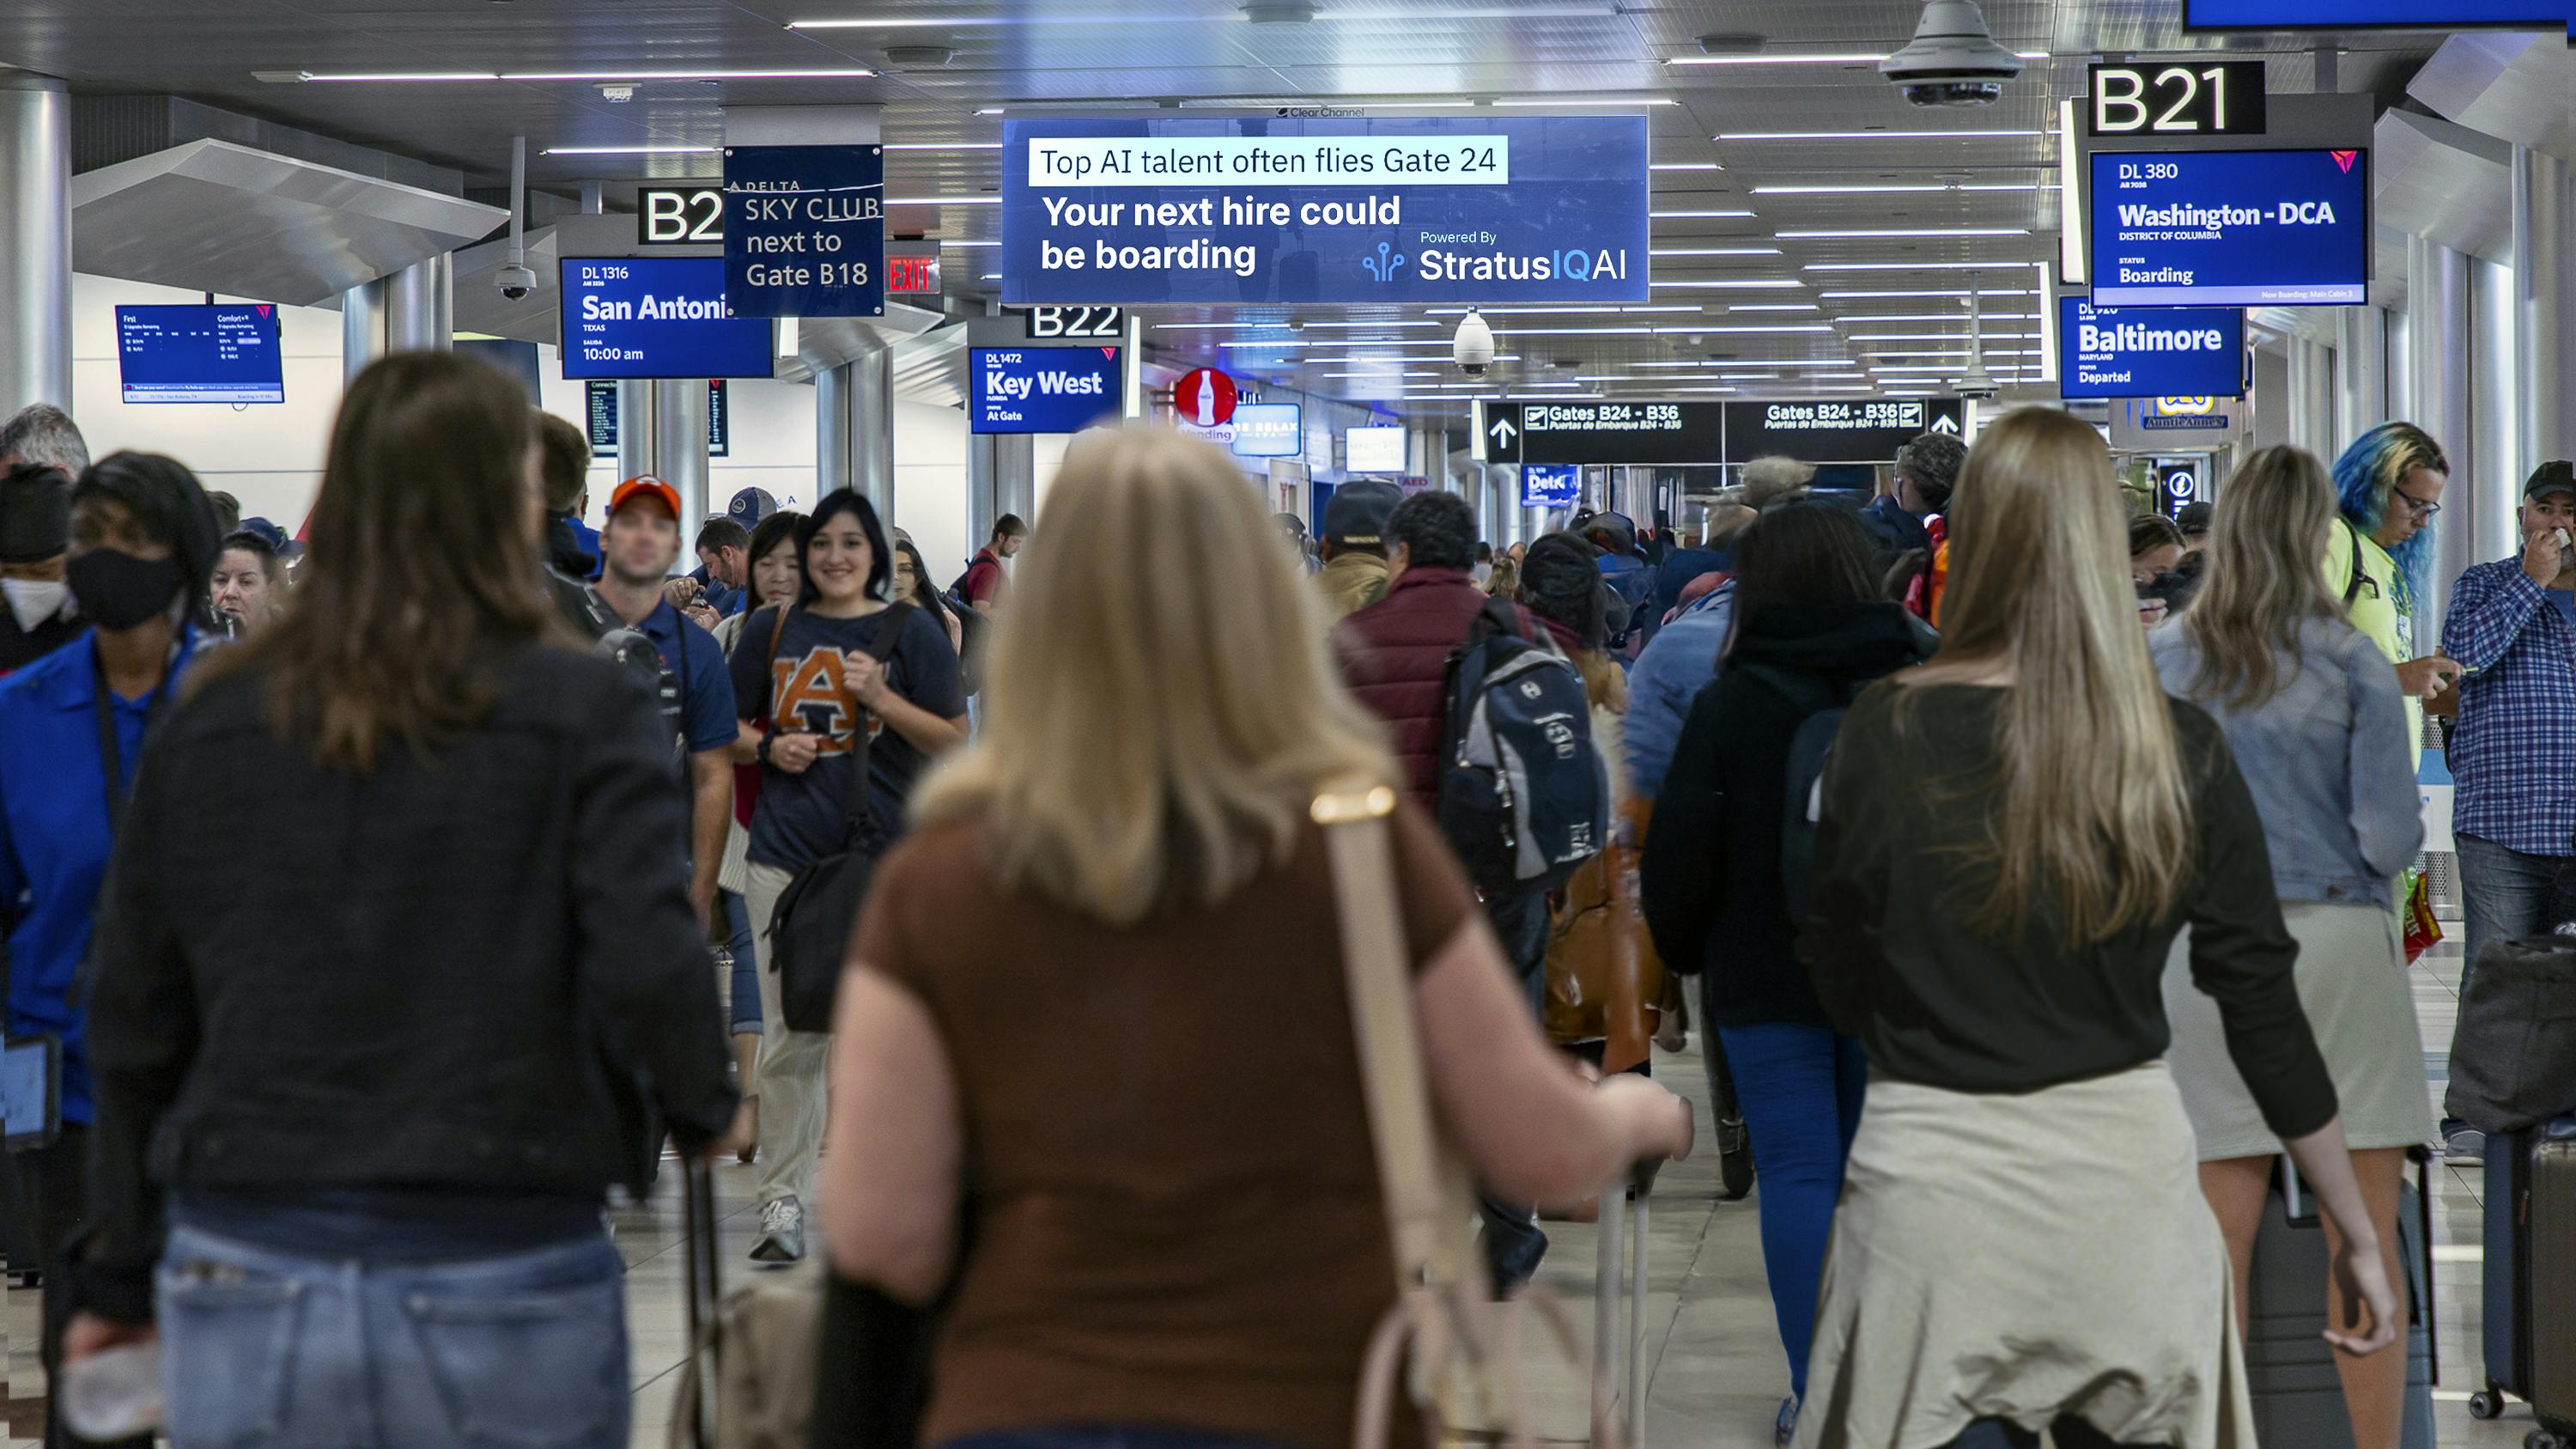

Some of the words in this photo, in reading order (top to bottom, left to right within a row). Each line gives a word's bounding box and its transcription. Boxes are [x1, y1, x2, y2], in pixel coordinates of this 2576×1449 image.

[2097, 68, 2225, 131] B21
[1291, 107, 1319, 117] Clear
[1321, 107, 1364, 117] Channel
[1041, 150, 1091, 180] Top
[1101, 149, 1132, 174] AI
[1141, 149, 1223, 174] talent
[1233, 148, 1304, 173] often
[1315, 148, 1374, 173] flies
[1384, 148, 1450, 173] Gate
[1461, 148, 1497, 172] 24
[2119, 164, 2142, 180] DL
[2145, 164, 2178, 179] 380
[747, 180, 800, 191] DELTA
[648, 191, 723, 240] B2
[745, 198, 798, 221] SKY
[807, 198, 879, 220] CLUB
[1042, 197, 1124, 227] Your
[1134, 199, 1212, 226] next
[1223, 195, 1290, 226] hire
[1301, 195, 1400, 226] could
[2118, 204, 2260, 230] Washington
[2279, 202, 2336, 224] DCA
[747, 232, 805, 253] next
[813, 231, 841, 252] to
[1420, 231, 1476, 243] Powered
[1481, 232, 1497, 246] By
[2119, 232, 2160, 240] DISTRICT
[2174, 231, 2221, 240] COLUMBIA
[1042, 240, 1085, 269] be
[1096, 238, 1255, 277] boarding
[1419, 248, 1625, 282] StratusIQAI
[582, 266, 600, 279] DL
[601, 266, 629, 279] 1316
[747, 264, 810, 286] Gate
[821, 263, 867, 285] B18
[890, 259, 930, 291] EXIT
[2120, 267, 2193, 284] Boarding
[582, 295, 631, 320] San
[638, 294, 726, 320] Antoni
[2079, 303, 2094, 314] DL
[1034, 307, 1119, 337] B22
[2079, 323, 2222, 352] Baltimore
[584, 348, 621, 360] 10:00
[623, 350, 643, 360] am
[987, 353, 999, 363] DL
[999, 353, 1022, 363] 1472
[987, 371, 1033, 400] Key
[1037, 371, 1103, 394] West
[2079, 371, 2130, 385] Departed
[987, 411, 999, 421] At
[999, 411, 1023, 421] Gate
[1549, 405, 1595, 421] Gates
[1599, 405, 1631, 421] B24
[1647, 405, 1679, 420] B36
[1767, 405, 1814, 421] Gates
[1818, 405, 1850, 419] B24
[1866, 404, 1898, 419] B36
[1255, 423, 1297, 432] RELAX
[1549, 420, 1581, 429] Puertas
[1583, 420, 1595, 429] de
[1595, 420, 1639, 430] Embarque
[1639, 420, 1657, 429] B24
[1664, 419, 1682, 429] B36
[1765, 419, 1796, 429] Puertas
[1798, 419, 1810, 429] de
[1811, 419, 1854, 429] Embarque
[1855, 419, 1873, 429] B24
[1880, 418, 1898, 429] B36
